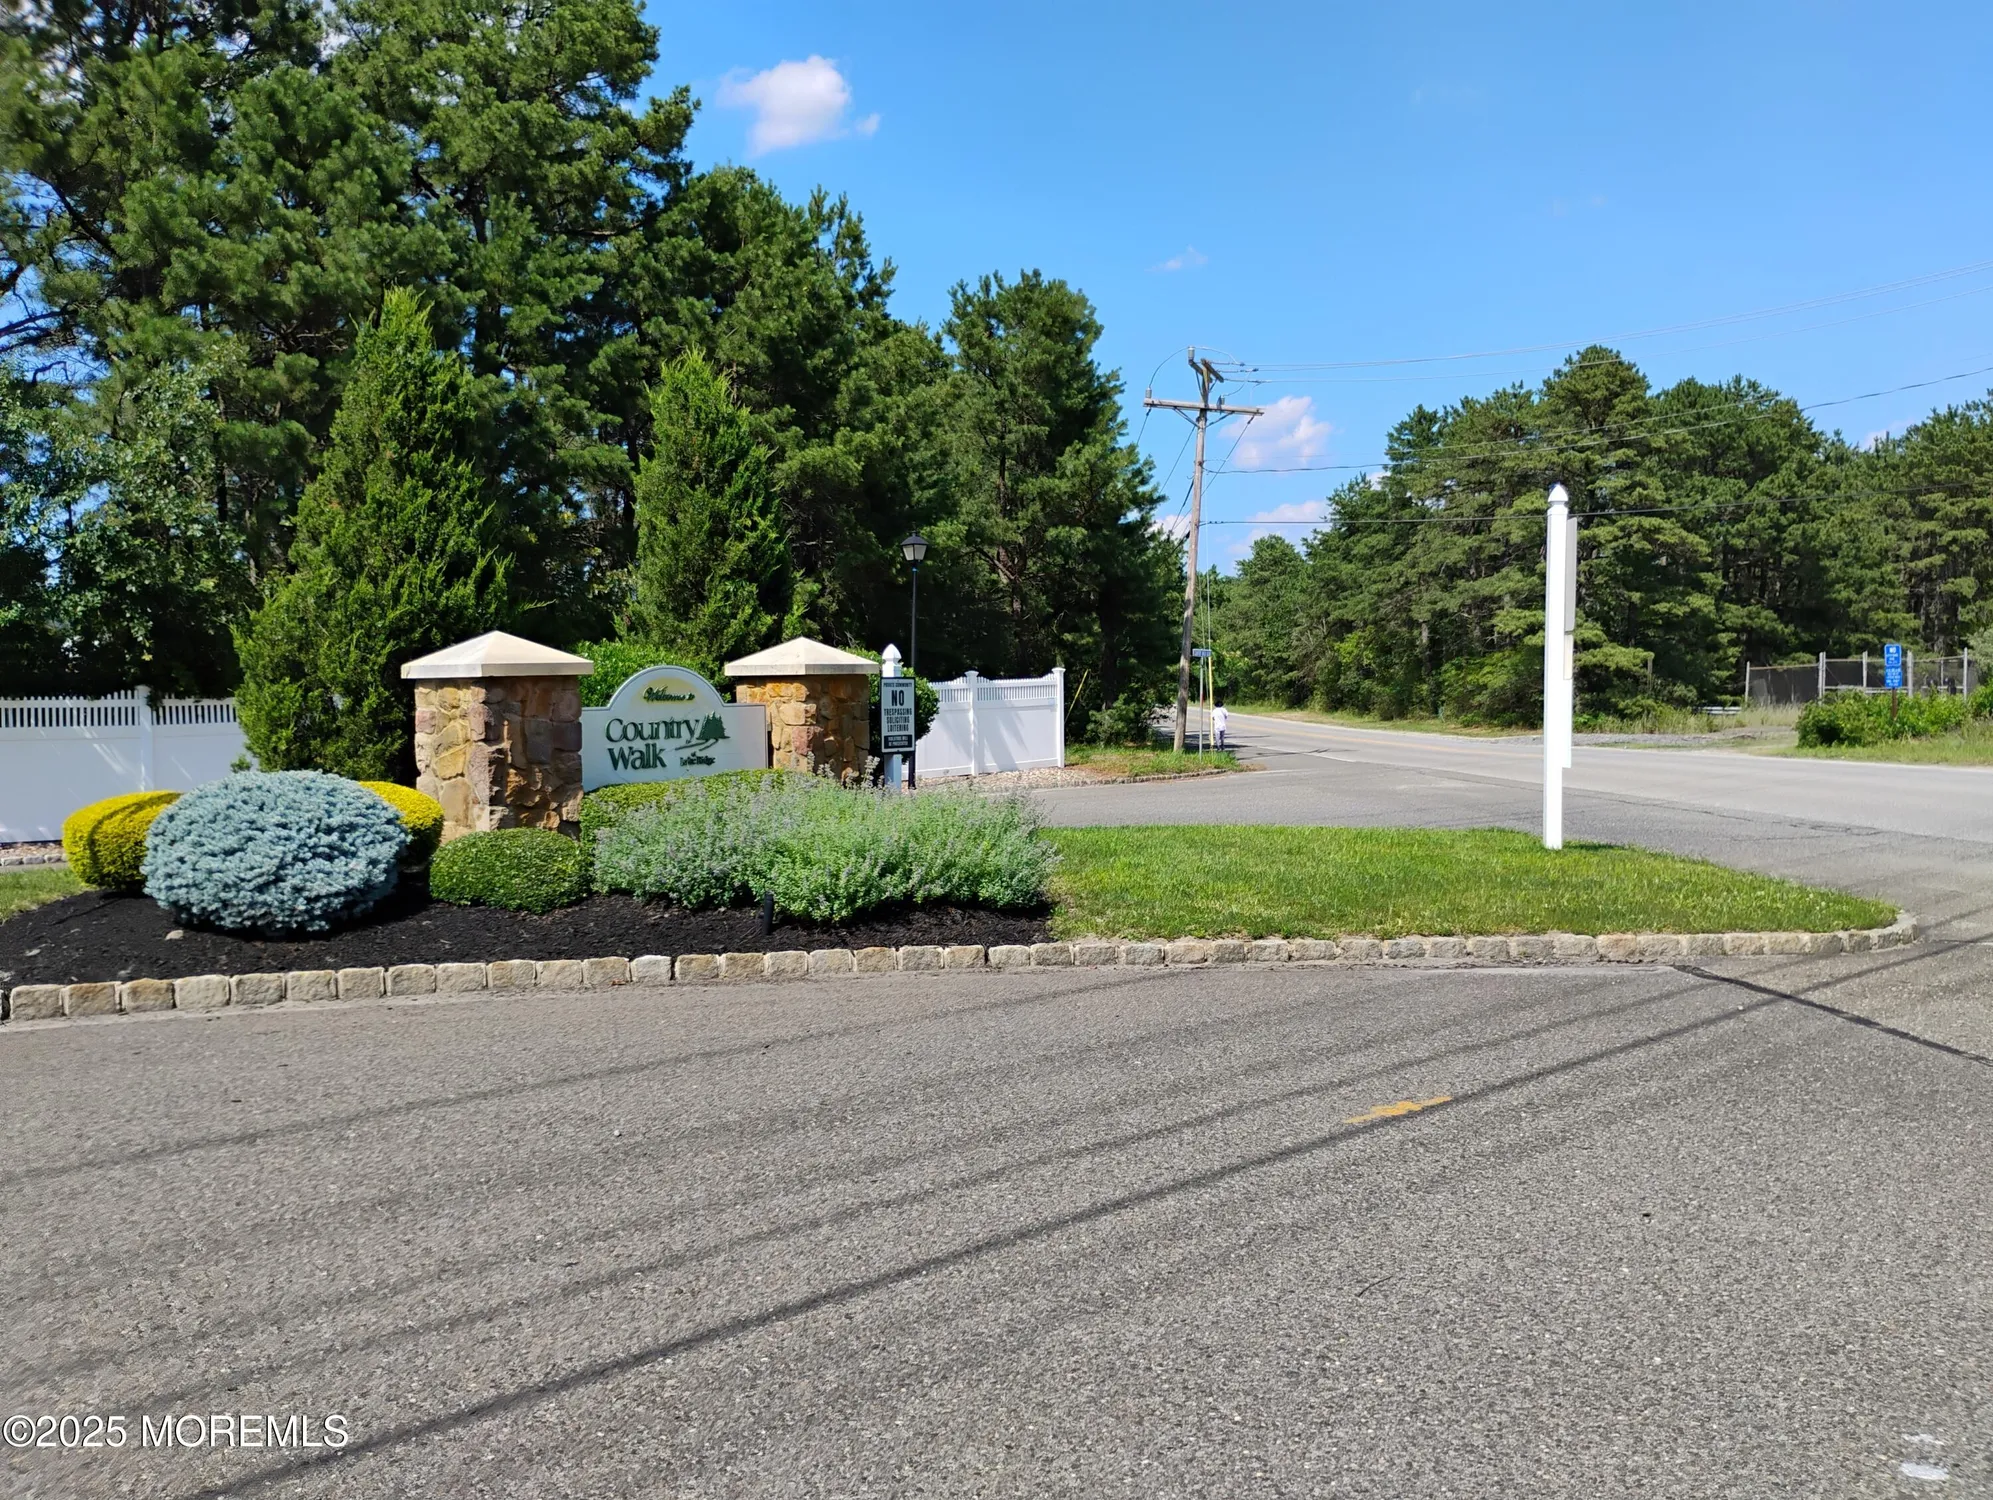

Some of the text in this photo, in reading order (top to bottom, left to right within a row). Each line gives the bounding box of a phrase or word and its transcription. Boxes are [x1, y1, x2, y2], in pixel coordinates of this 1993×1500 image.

[891, 690, 904, 706] NO
[606, 718, 700, 744] Country
[607, 743, 667, 771] Walk
